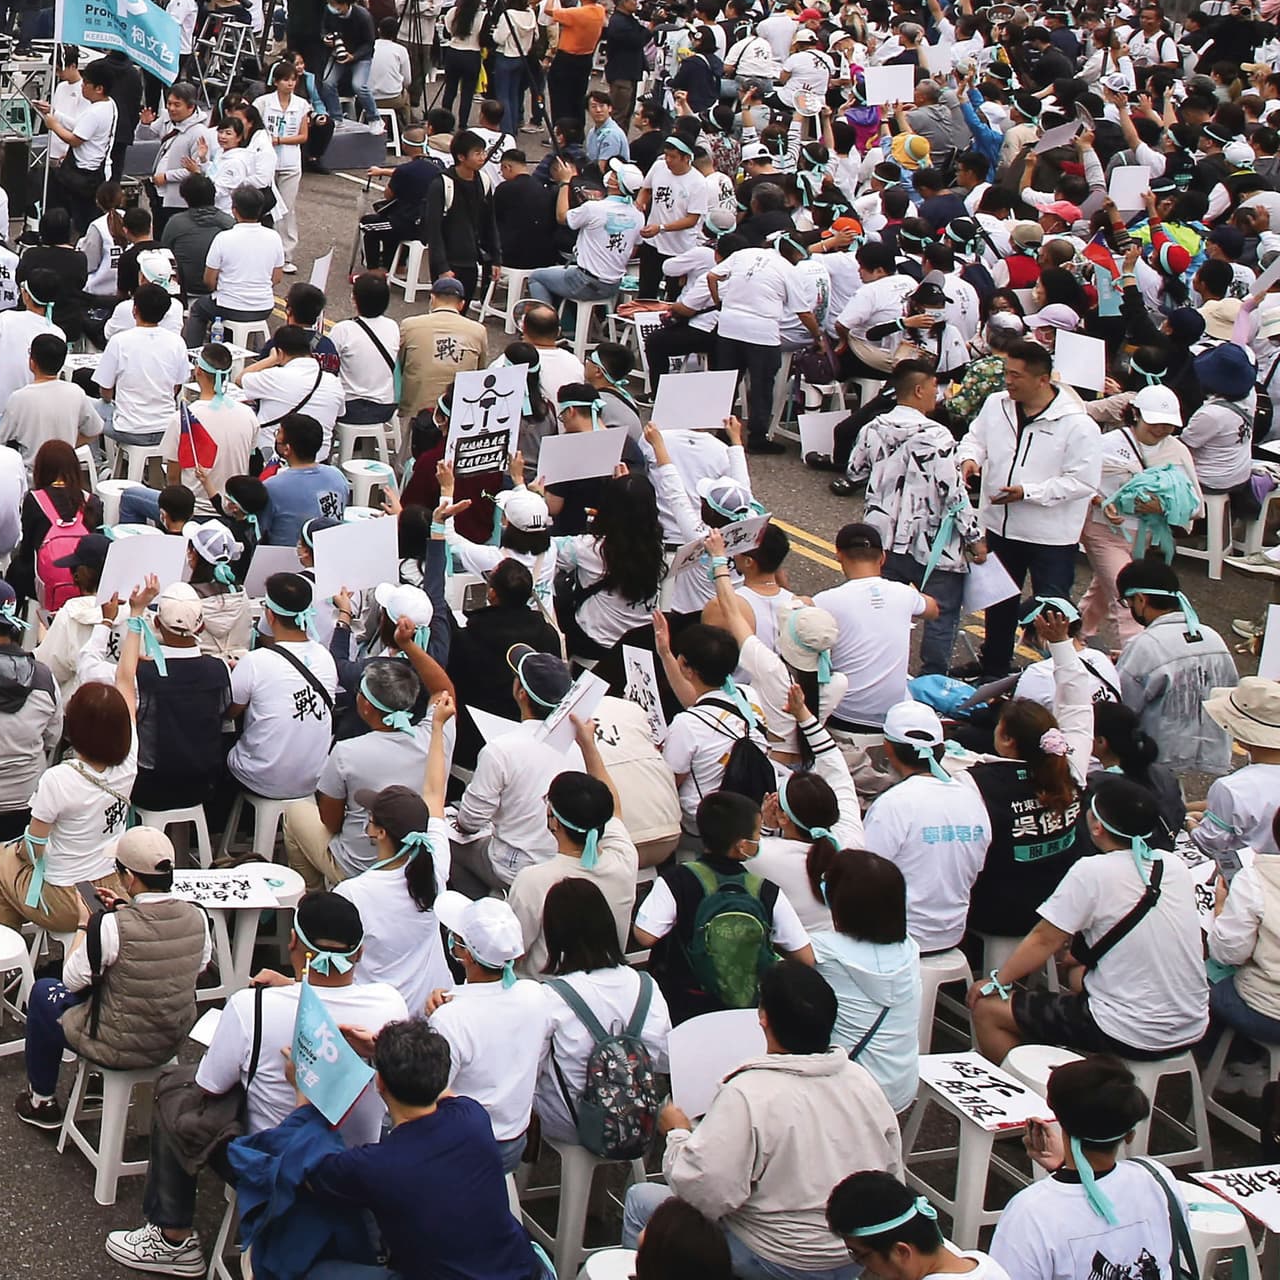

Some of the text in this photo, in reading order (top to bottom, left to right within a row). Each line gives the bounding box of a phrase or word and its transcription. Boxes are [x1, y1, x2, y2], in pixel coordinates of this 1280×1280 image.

[434, 337, 465, 363] 戰!
[319, 491, 344, 522] 戰!
[292, 684, 327, 722] 戰!
